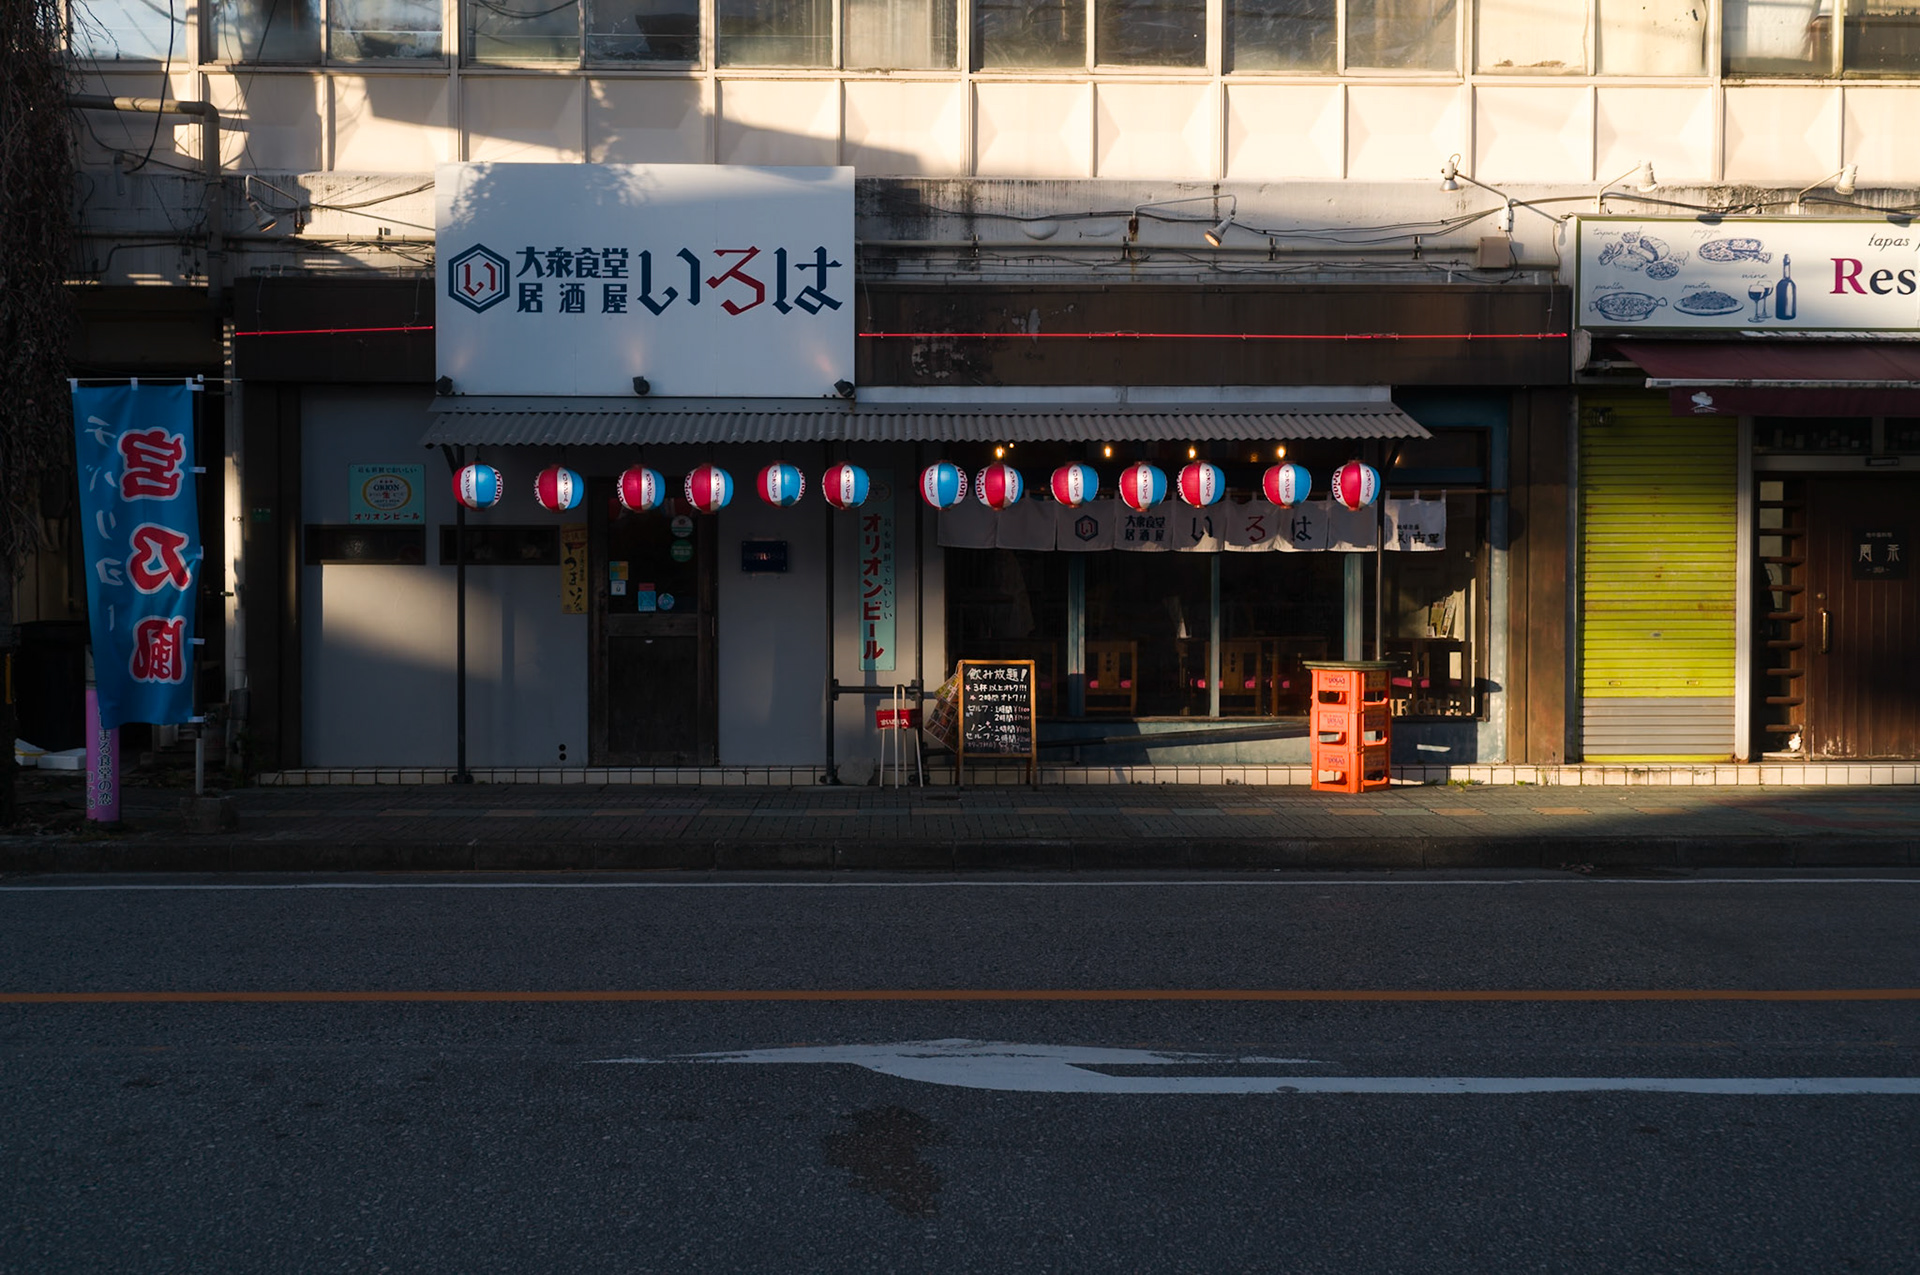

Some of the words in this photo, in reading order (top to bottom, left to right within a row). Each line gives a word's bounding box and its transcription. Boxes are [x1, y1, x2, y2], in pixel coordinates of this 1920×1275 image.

[1868, 233, 1910, 251] tapas
[516, 246, 629, 279] 大衆食堂
[1829, 258, 1920, 295] Res
[464, 262, 496, 296] い
[637, 245, 843, 316] いろは
[517, 283, 628, 313] 居酒屋
[1125, 515, 1166, 528] 大衆食堂
[1125, 529, 1166, 541] 居酒屋
[1191, 515, 1312, 542] いろは
[117, 427, 192, 684] 宮乃風
[864, 513, 884, 660] オリオンビール
[967, 667, 1028, 682] 飲み放題!
